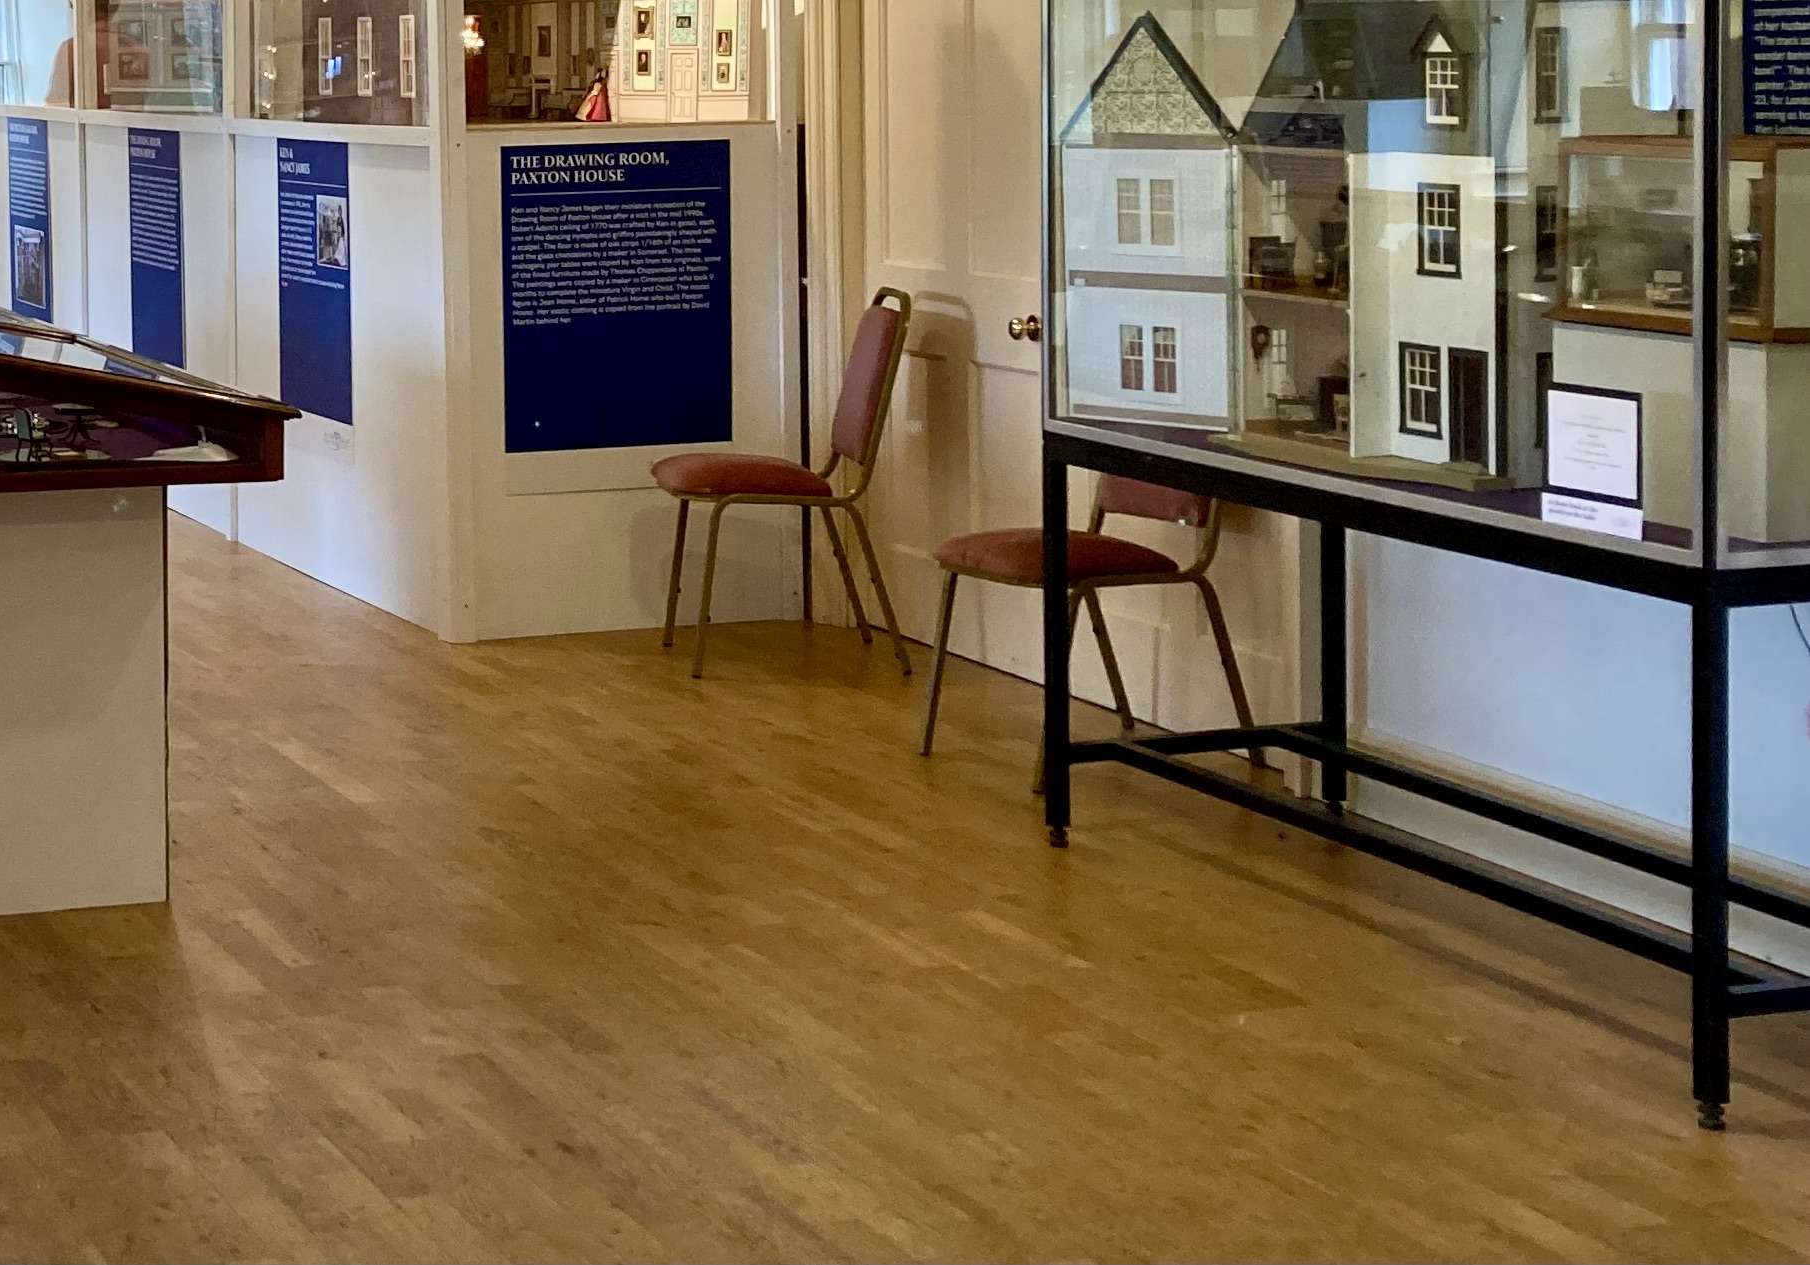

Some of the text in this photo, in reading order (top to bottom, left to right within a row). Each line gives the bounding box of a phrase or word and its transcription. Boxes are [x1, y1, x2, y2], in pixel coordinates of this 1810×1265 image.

[510, 151, 669, 169] THE DRAWING ROOM,
[511, 168, 624, 184] PAXTON HOUSE
